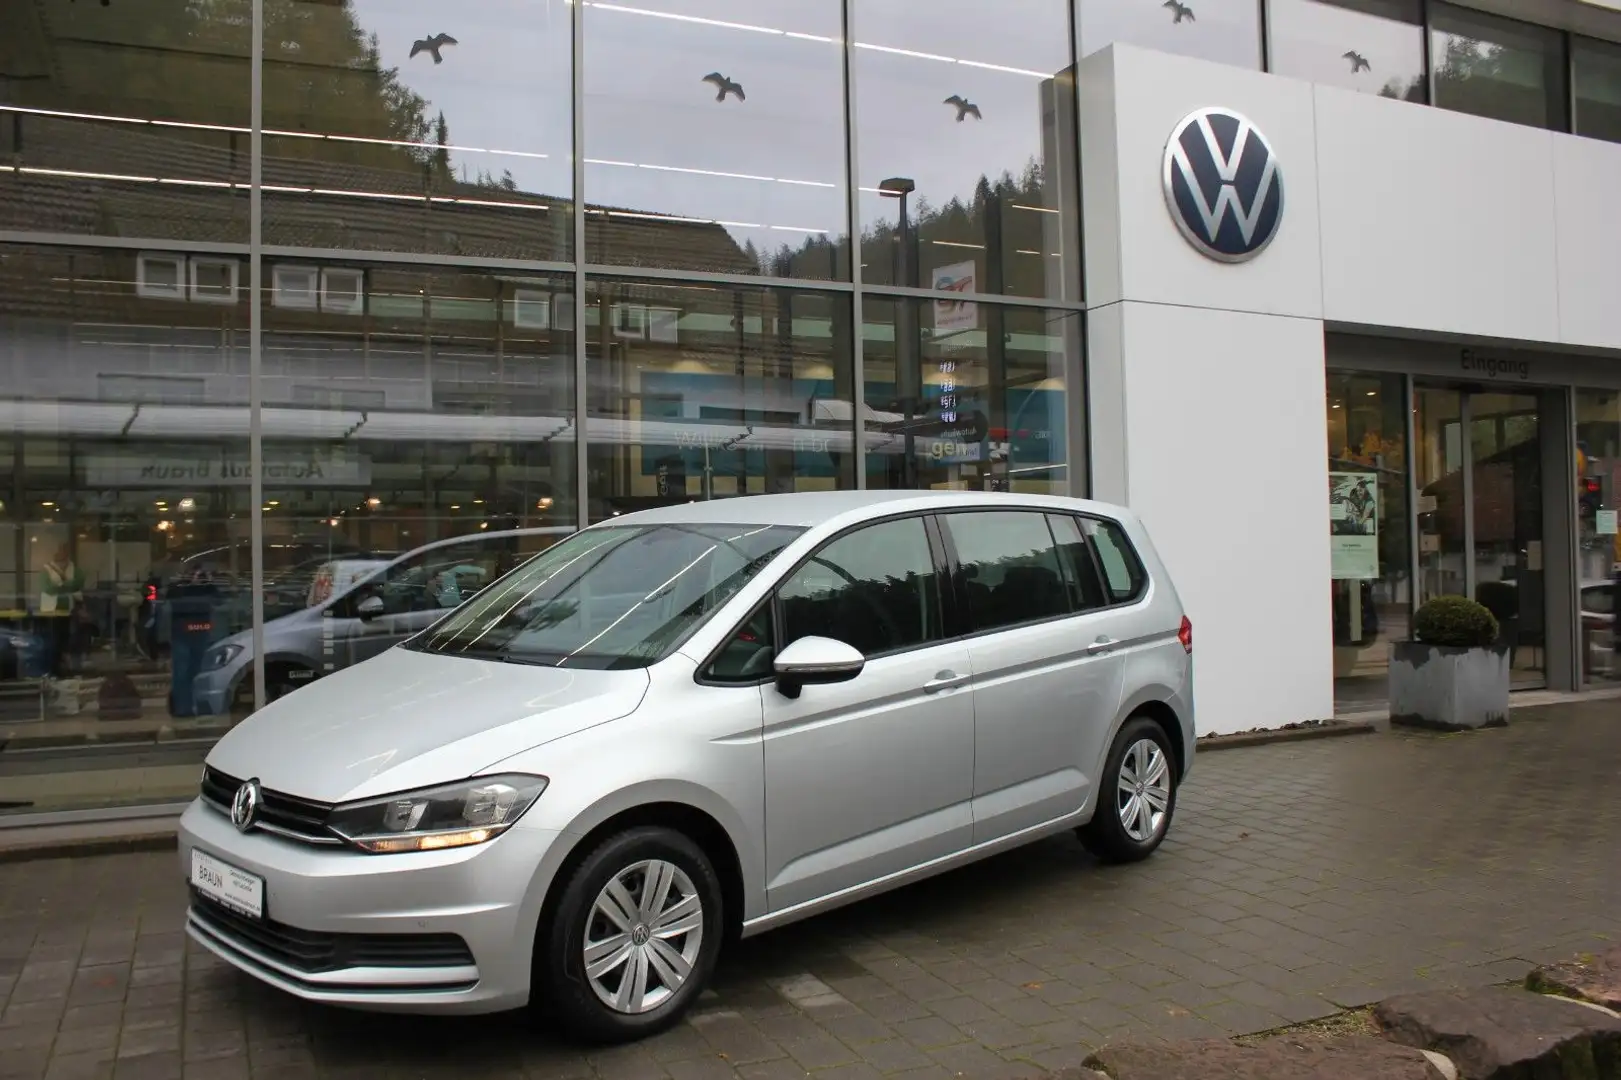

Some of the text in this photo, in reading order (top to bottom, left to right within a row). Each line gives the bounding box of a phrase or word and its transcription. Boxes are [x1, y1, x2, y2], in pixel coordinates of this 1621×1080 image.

[1163, 106, 1284, 263] VW
[1460, 348, 1529, 379] Eingang
[199, 864, 223, 888] BRAUN
